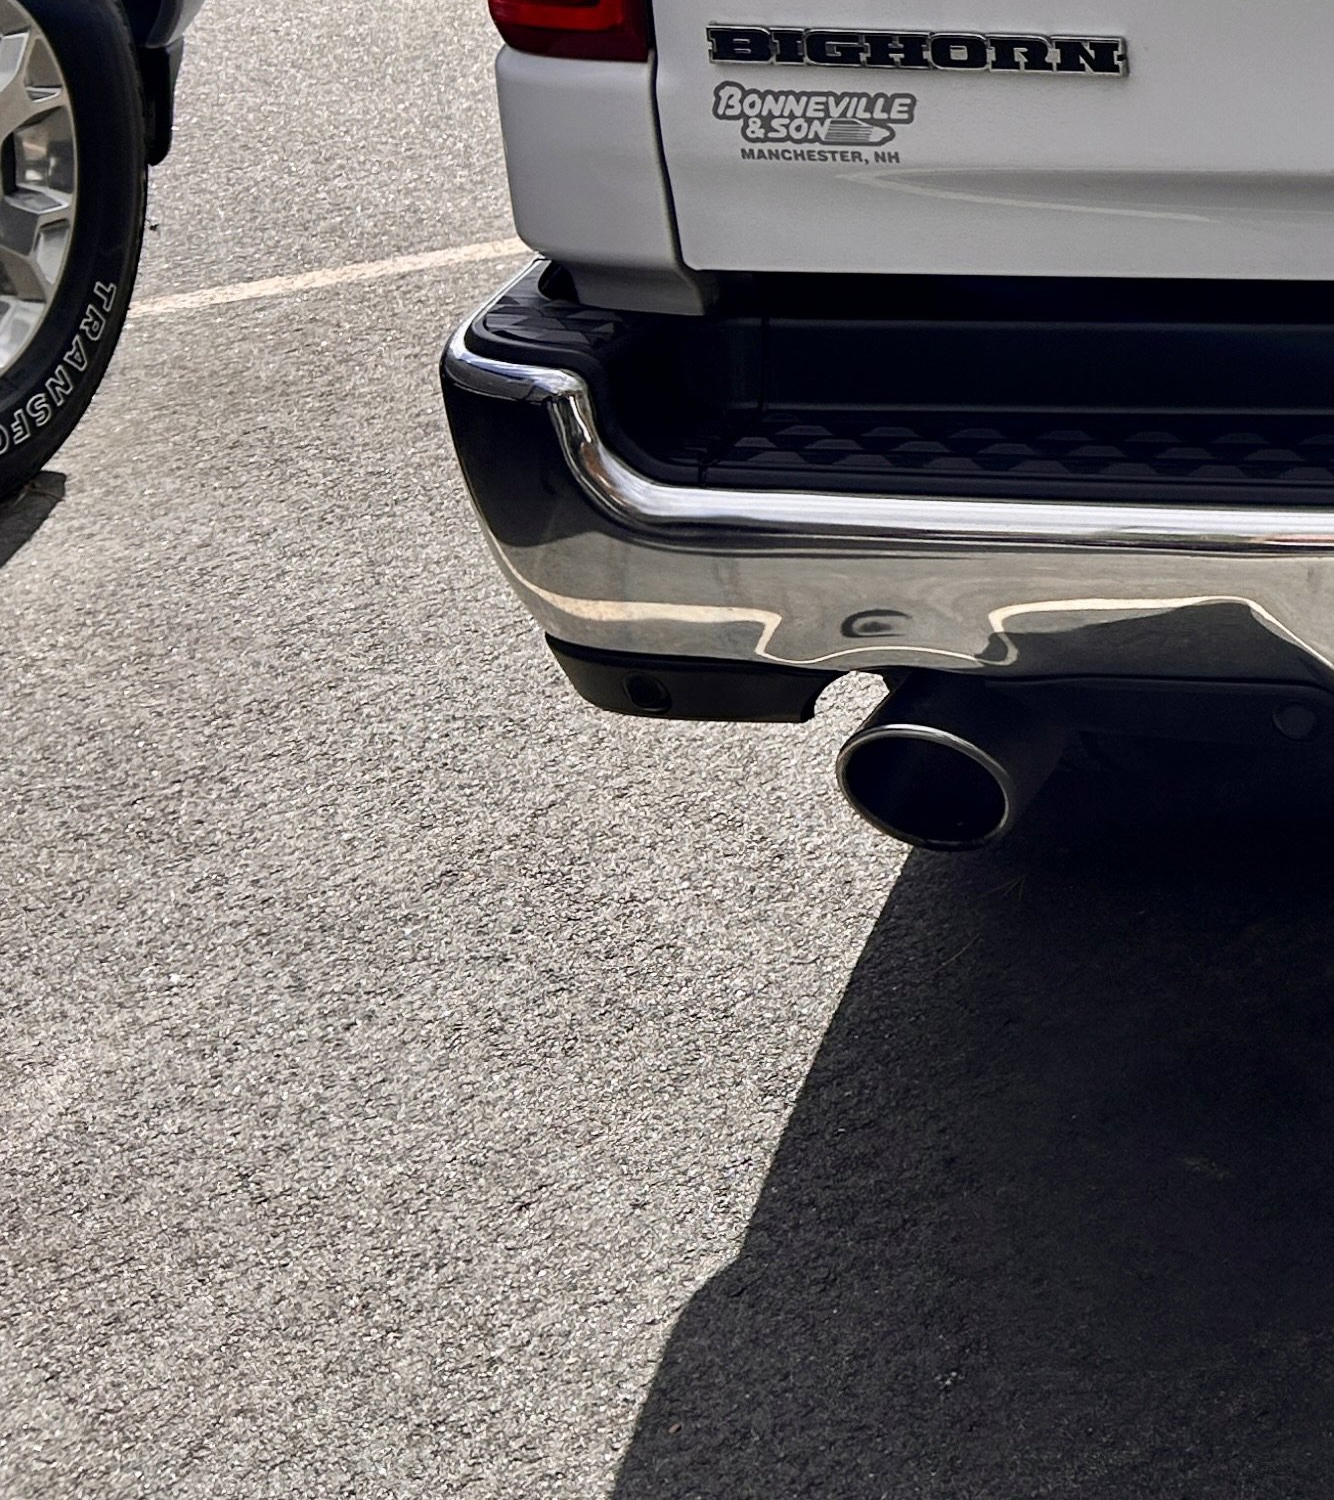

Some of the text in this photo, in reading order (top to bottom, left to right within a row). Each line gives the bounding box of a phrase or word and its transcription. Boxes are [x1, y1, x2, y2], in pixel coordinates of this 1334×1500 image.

[706, 23, 1130, 77] BIGHORN
[715, 84, 913, 121] BONNEVILLE
[740, 147, 901, 165] MANCHESTER, NH
